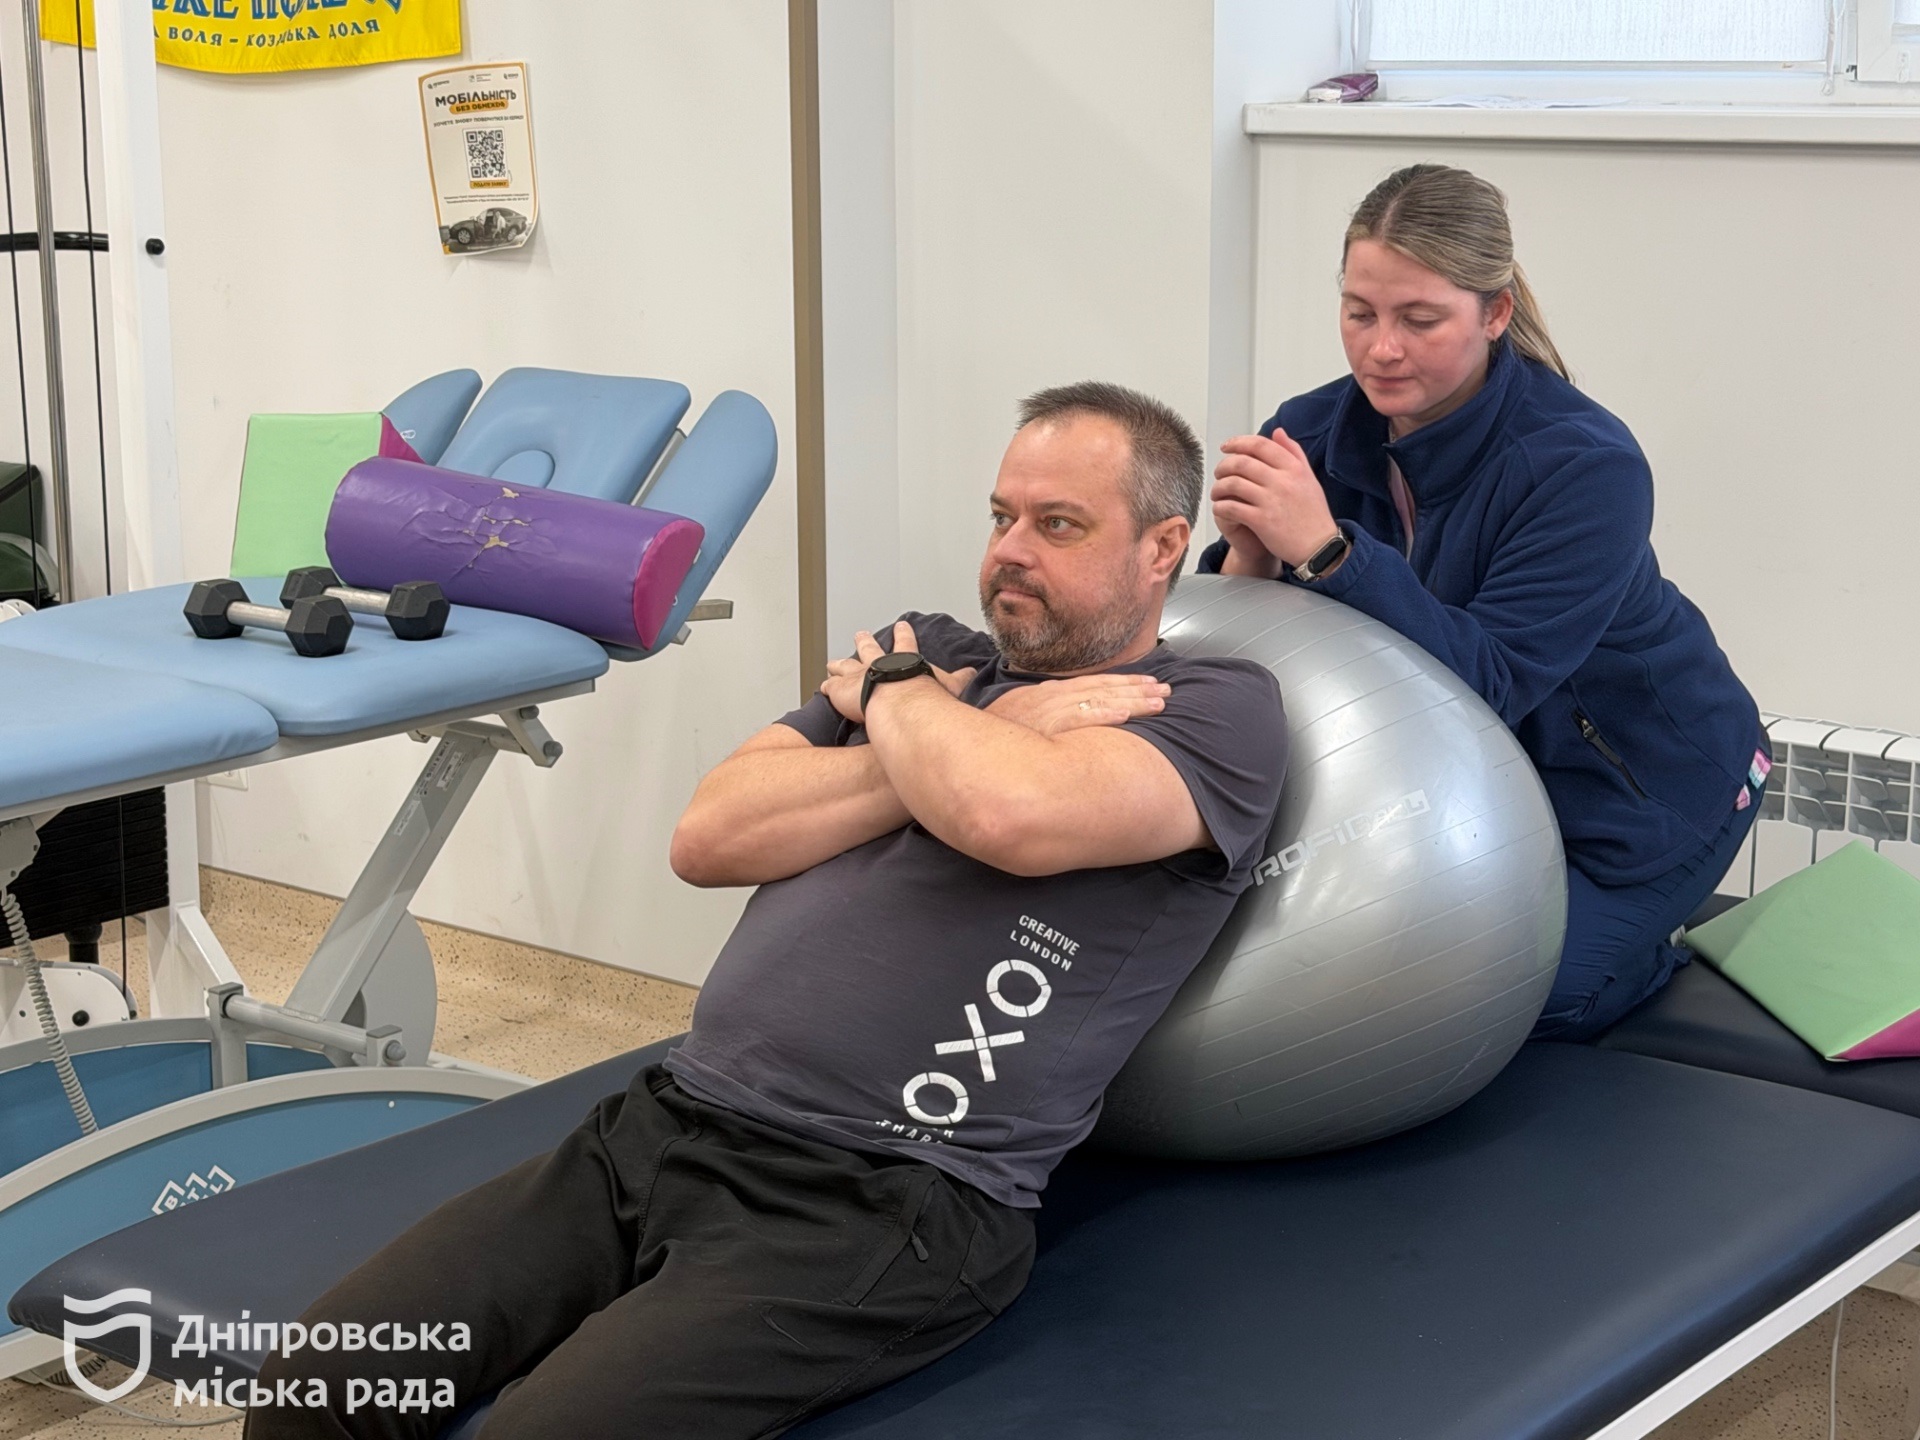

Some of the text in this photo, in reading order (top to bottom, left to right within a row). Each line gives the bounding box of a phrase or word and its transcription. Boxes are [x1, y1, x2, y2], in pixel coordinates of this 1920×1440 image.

[168, 27, 222, 46] ВОЛЯ
[328, 19, 380, 39] ДОЛЯ
[435, 89, 517, 107] МОБІЛЬНІСТЬ
[456, 104, 471, 112] БЕЗ
[1010, 930, 1073, 972] LONDON
[1018, 914, 1080, 956] CREATIVE
[903, 959, 1052, 1125] OXO
